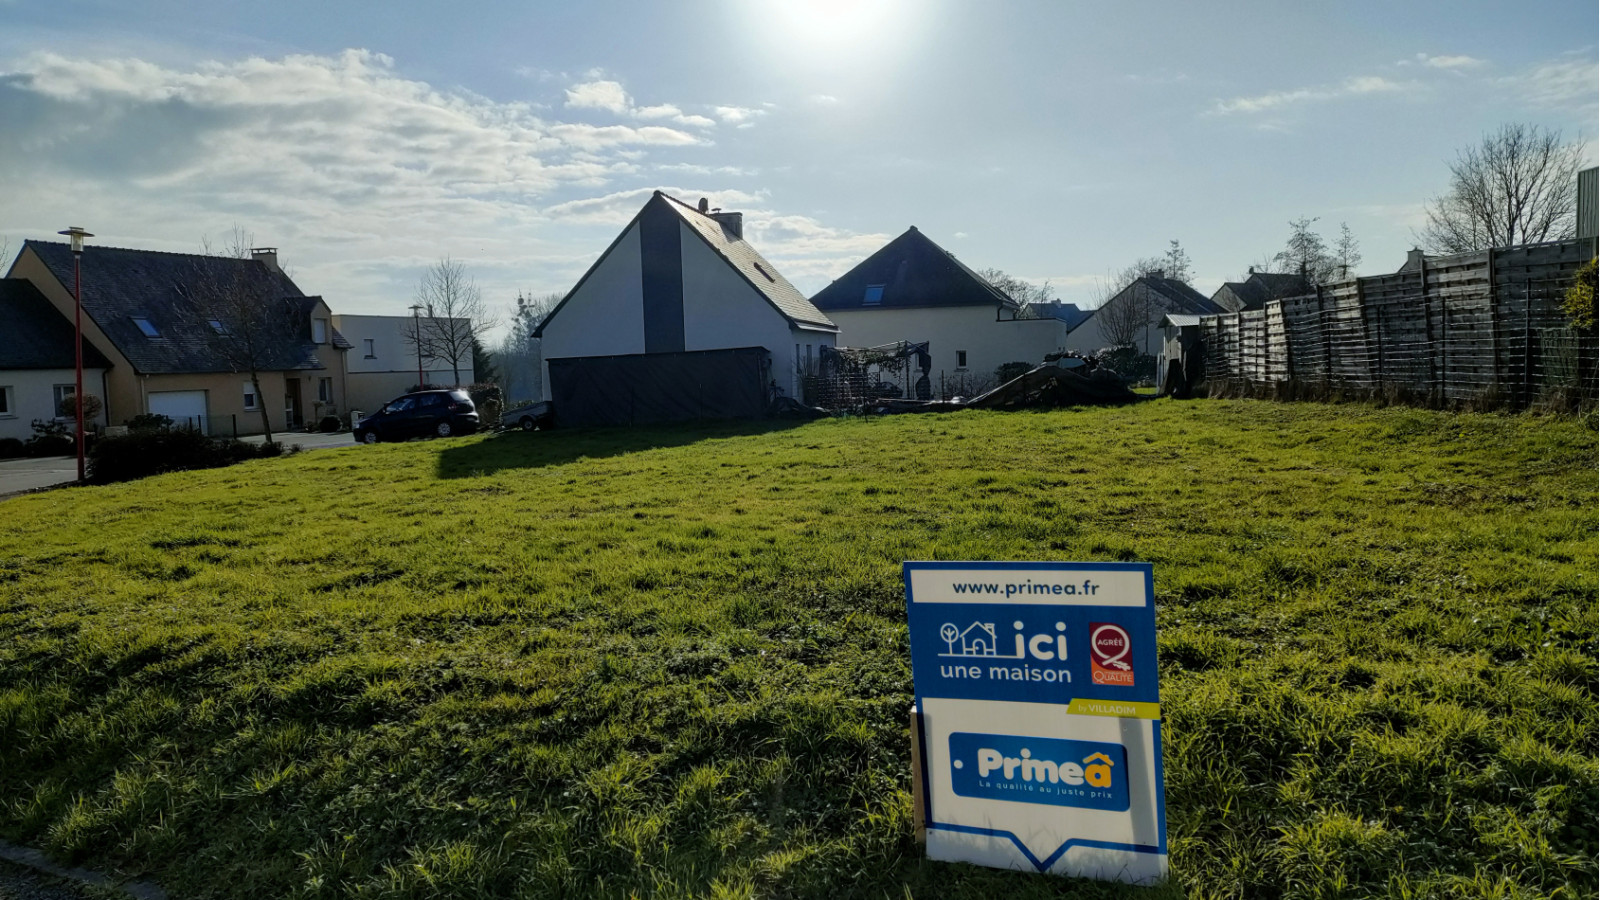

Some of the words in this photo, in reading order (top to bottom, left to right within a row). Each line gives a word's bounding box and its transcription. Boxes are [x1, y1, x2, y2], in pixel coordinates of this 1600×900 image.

[952, 579, 1100, 598] www.primea.fr
[1013, 620, 1069, 661] ici
[1097, 637, 1124, 647] AGRÉÉ
[940, 664, 982, 679] une
[989, 664, 1073, 683] maison
[1088, 703, 1137, 716] VILLADIM
[978, 780, 991, 788] La
[996, 781, 1034, 792] qualité
[1056, 787, 1085, 796] juste
[1090, 789, 1113, 799] prix
